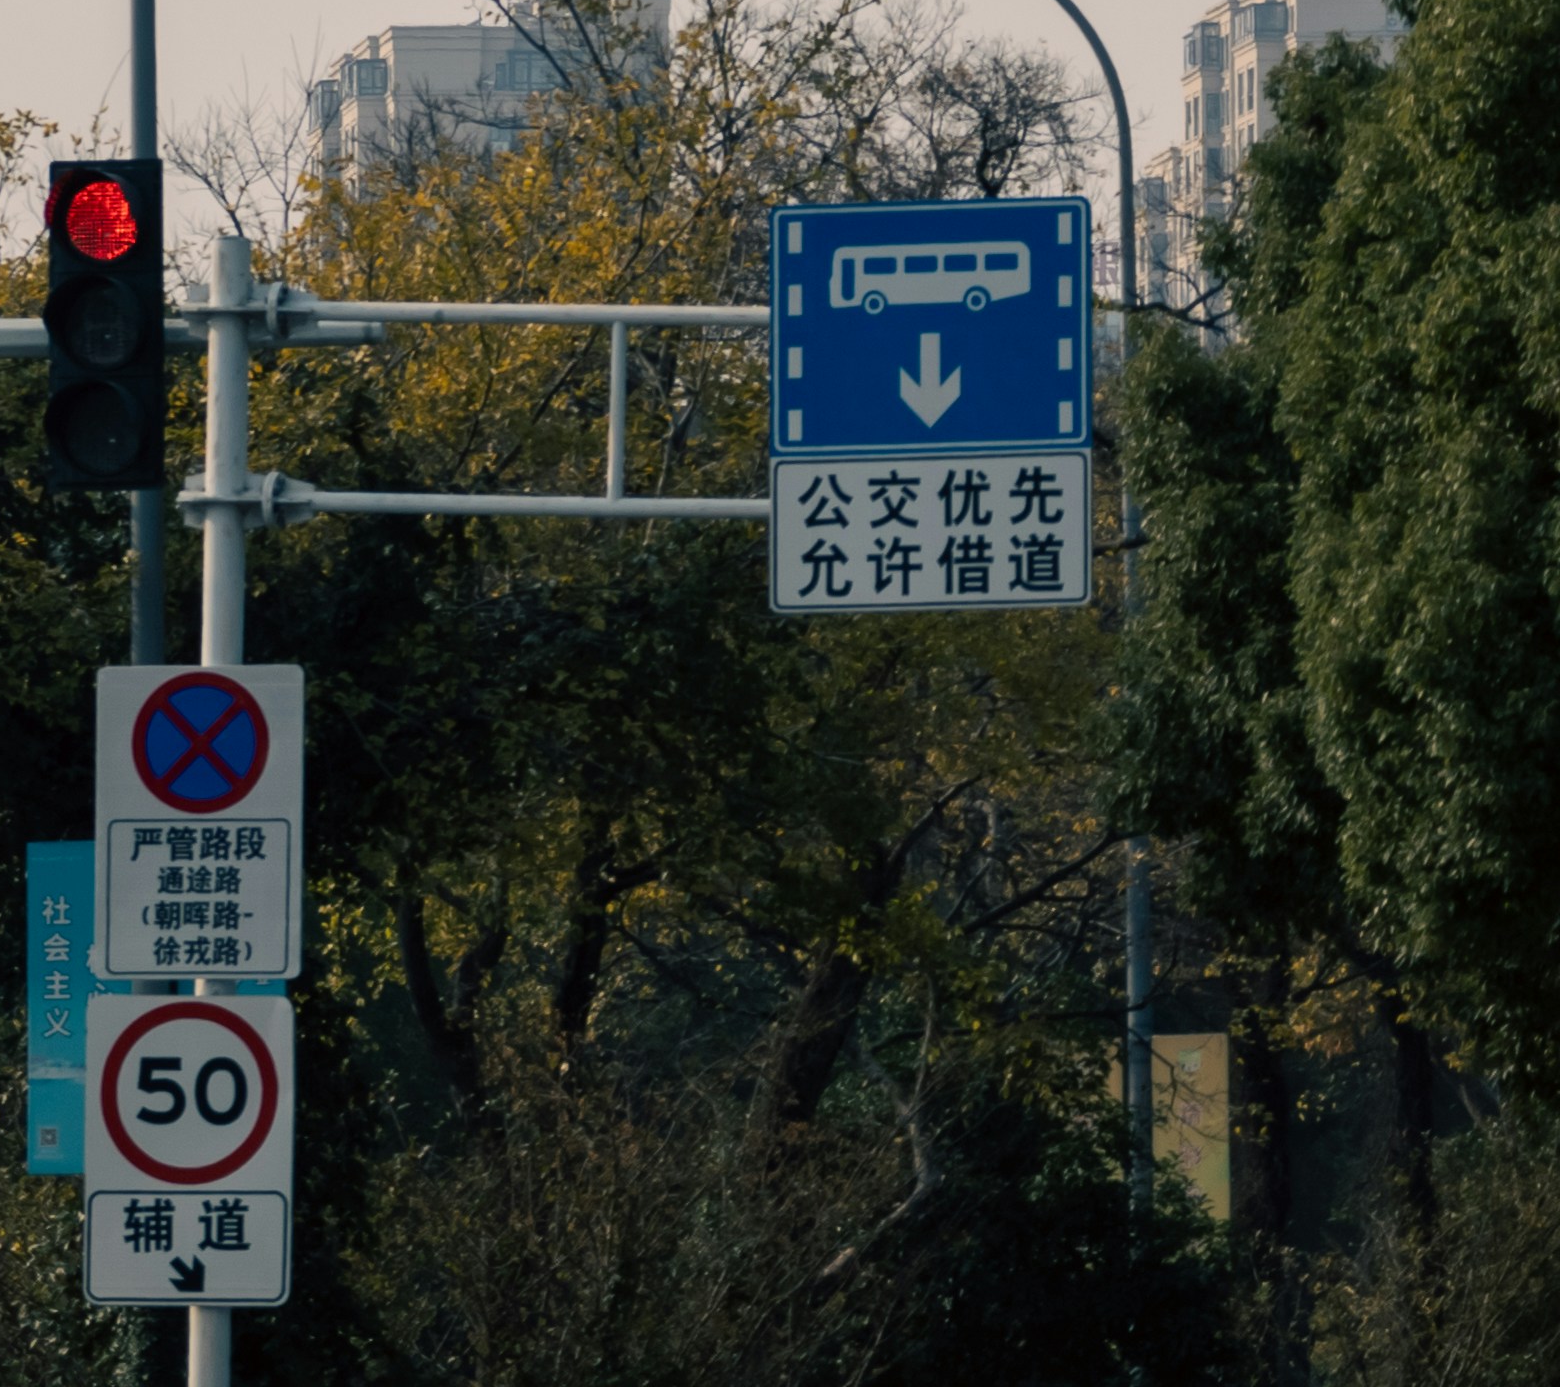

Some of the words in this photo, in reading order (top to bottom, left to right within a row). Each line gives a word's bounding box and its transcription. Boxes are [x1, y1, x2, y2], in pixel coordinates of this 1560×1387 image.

[797, 466, 1065, 529] 公交优先
[797, 533, 1065, 598] 允许借道
[130, 826, 267, 862] 严管路段
[157, 865, 242, 895] 通途路
[41, 895, 71, 1038] 社会主义
[136, 1056, 248, 1126] 50
[123, 1197, 251, 1254] 辅道
